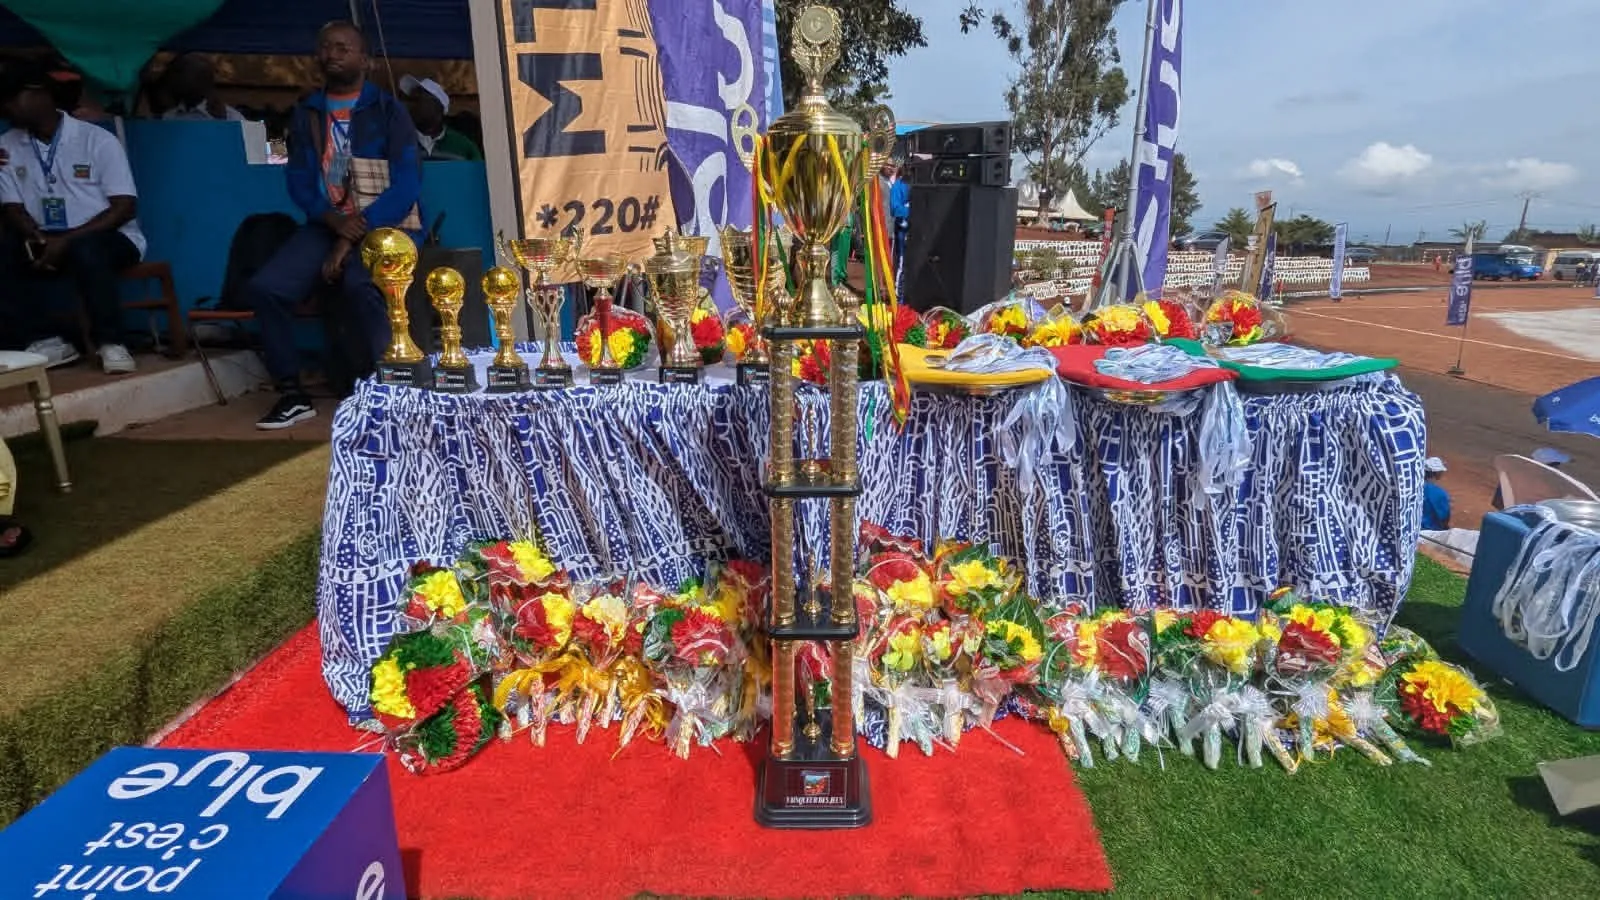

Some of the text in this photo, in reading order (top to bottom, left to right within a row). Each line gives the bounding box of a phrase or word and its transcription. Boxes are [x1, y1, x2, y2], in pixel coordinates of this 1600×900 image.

[107, 751, 325, 819] blue
[83, 822, 229, 858] c'est
[34, 858, 201, 900] point
